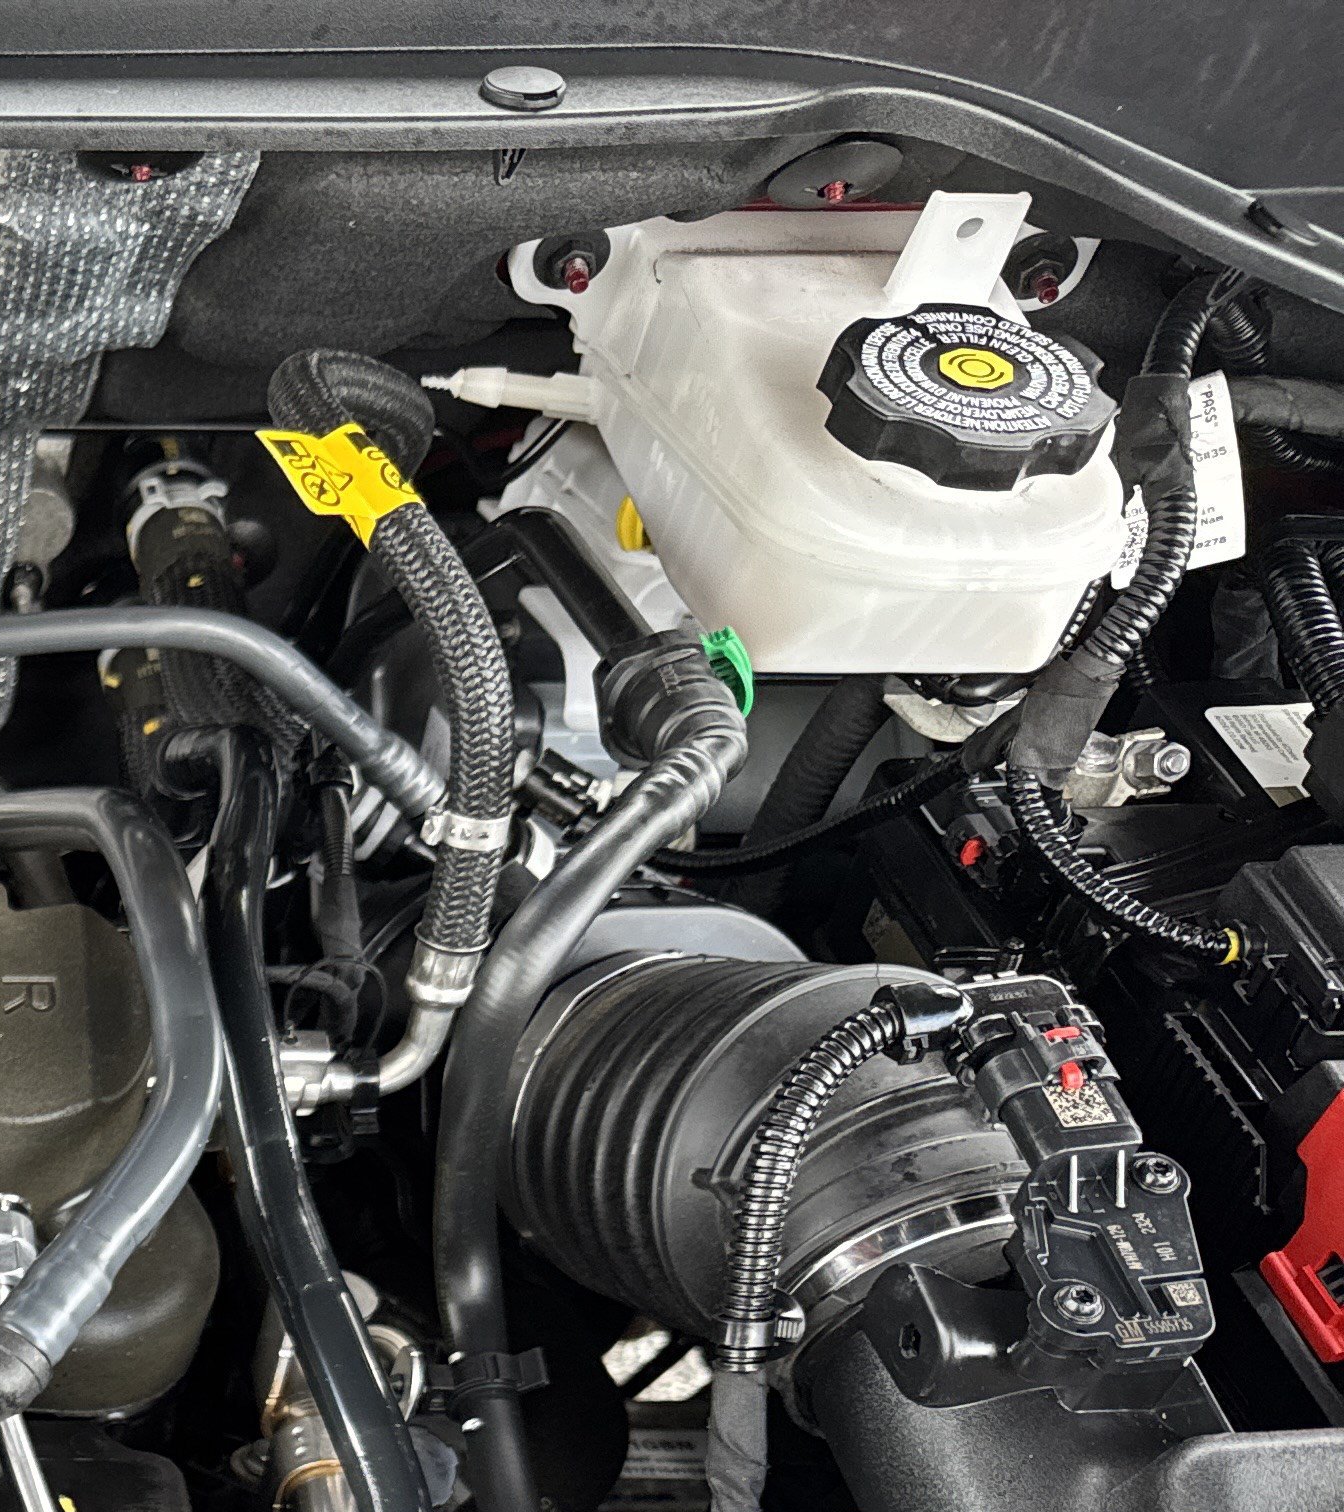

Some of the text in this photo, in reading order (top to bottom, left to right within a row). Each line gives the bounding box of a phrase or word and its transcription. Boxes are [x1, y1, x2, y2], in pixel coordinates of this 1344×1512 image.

[919, 321, 963, 334] ONLY
[933, 332, 988, 345] FILLER
[996, 318, 1056, 346] SEALED
[987, 337, 1037, 362] CLEAN
[942, 390, 1023, 408] PROVENANT
[2, 974, 57, 1015] R
[1114, 1321, 1145, 1343] GM
